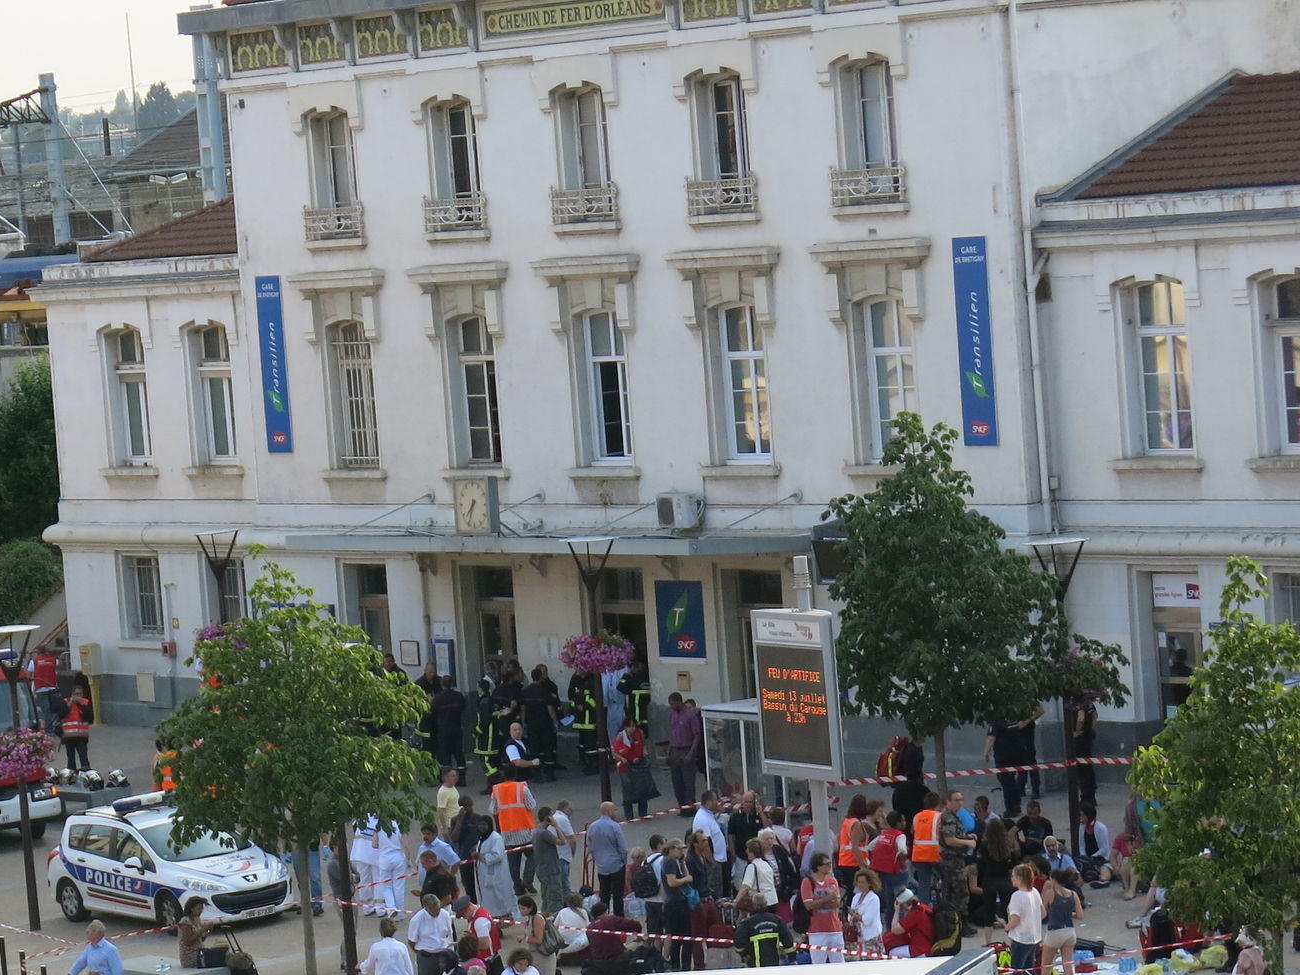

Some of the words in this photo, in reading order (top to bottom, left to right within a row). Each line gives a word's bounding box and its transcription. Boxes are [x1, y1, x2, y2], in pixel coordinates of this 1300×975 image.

[498, 11, 540, 30] CHEMIN
[543, 10, 557, 25] DE
[560, 6, 582, 23] FER
[967, 291, 983, 389] Transilien
[972, 425, 988, 434] SNCF
[677, 640, 696, 650] SNCF
[767, 667, 781, 679] FEU
[762, 688, 786, 701] Samedi
[789, 690, 798, 702] 13
[800, 692, 826, 705] juillet
[763, 699, 788, 712] Bassin
[789, 701, 798, 713] du
[85, 867, 132, 892] POLICE
